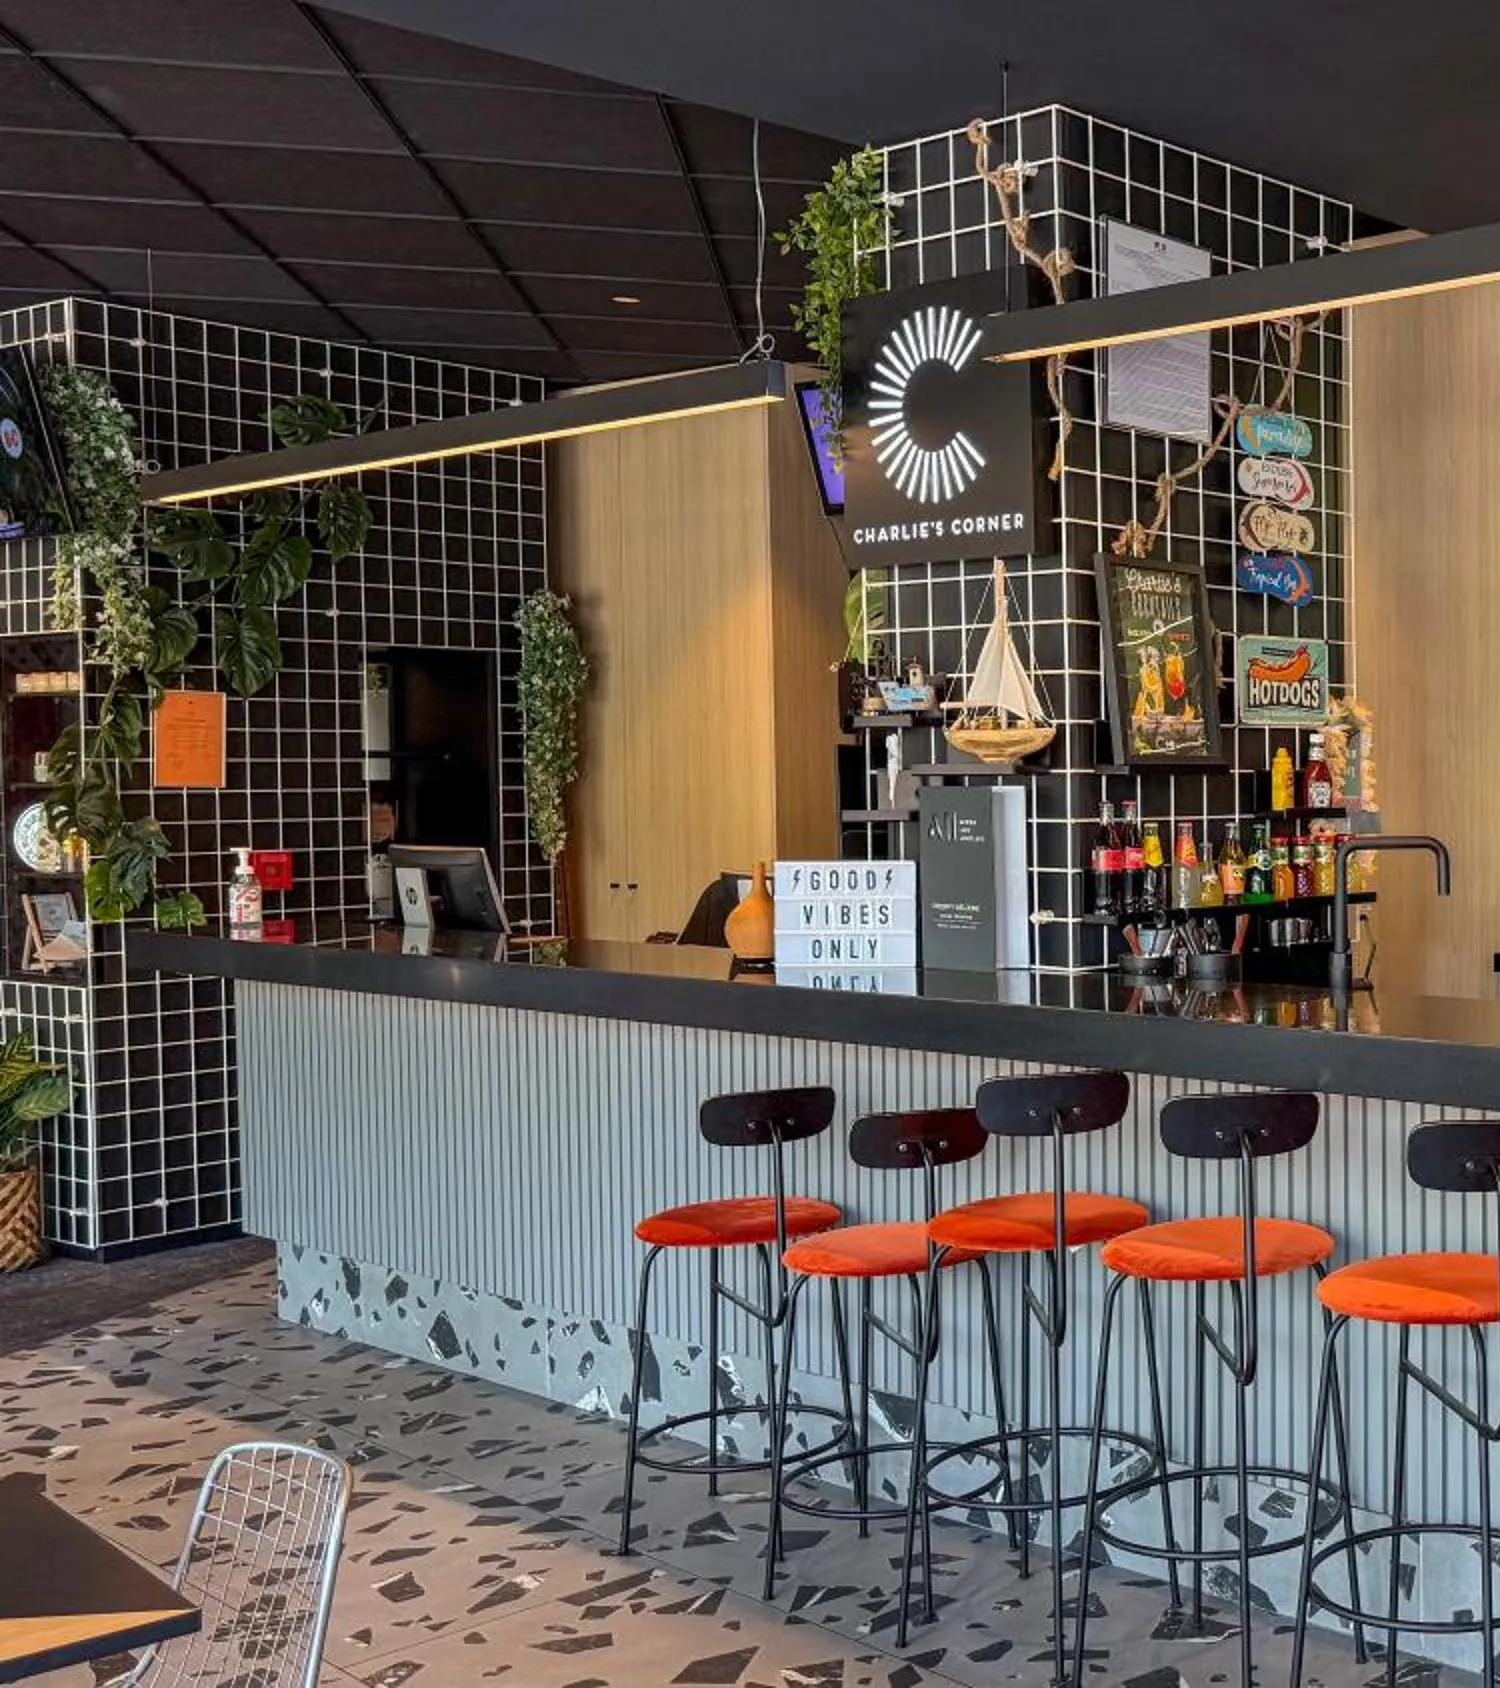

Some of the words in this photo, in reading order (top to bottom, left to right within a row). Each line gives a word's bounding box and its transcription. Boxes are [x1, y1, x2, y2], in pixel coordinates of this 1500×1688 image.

[853, 520, 944, 544] CHARLIE'S
[951, 513, 1024, 535] CORNER
[1249, 677, 1320, 708] HOTDOGS
[811, 869, 876, 890] GOOD
[803, 904, 889, 925] VIBES
[812, 939, 877, 959] ONLY
